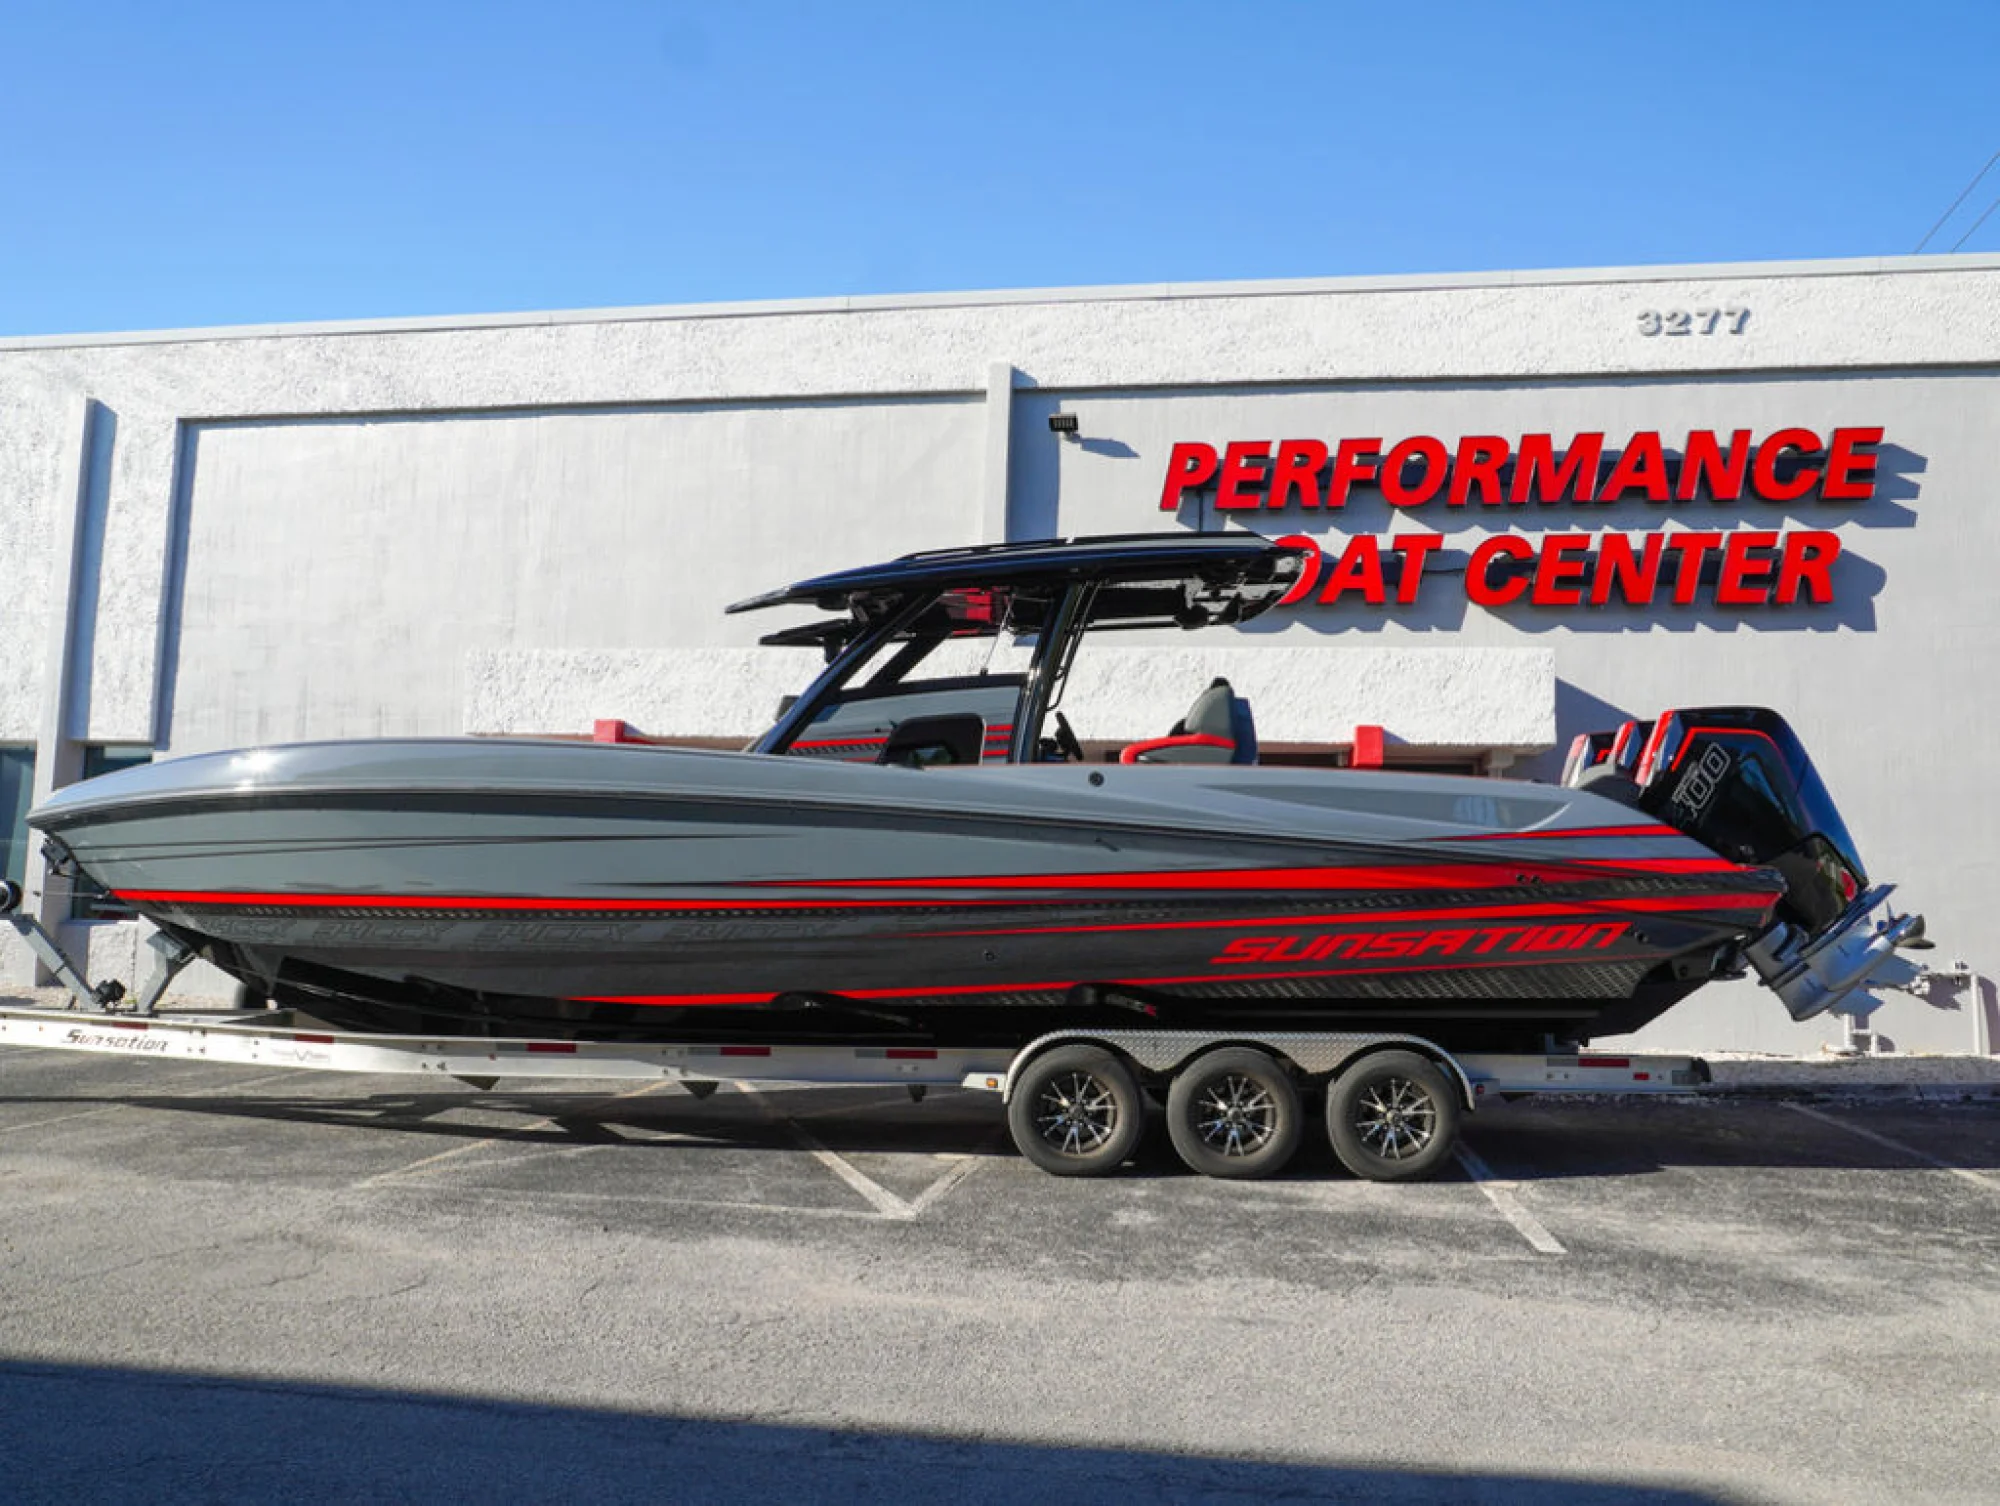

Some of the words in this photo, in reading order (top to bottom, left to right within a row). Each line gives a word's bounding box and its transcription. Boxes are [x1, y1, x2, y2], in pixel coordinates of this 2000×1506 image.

[1636, 307, 1751, 336] 3277
[1160, 427, 1884, 510] PERFORMANCE
[1274, 533, 1445, 605] OAT
[1465, 530, 1842, 607] CENTER
[1210, 921, 1633, 965] SUNSATION
[61, 1028, 169, 1052] Sunsation
